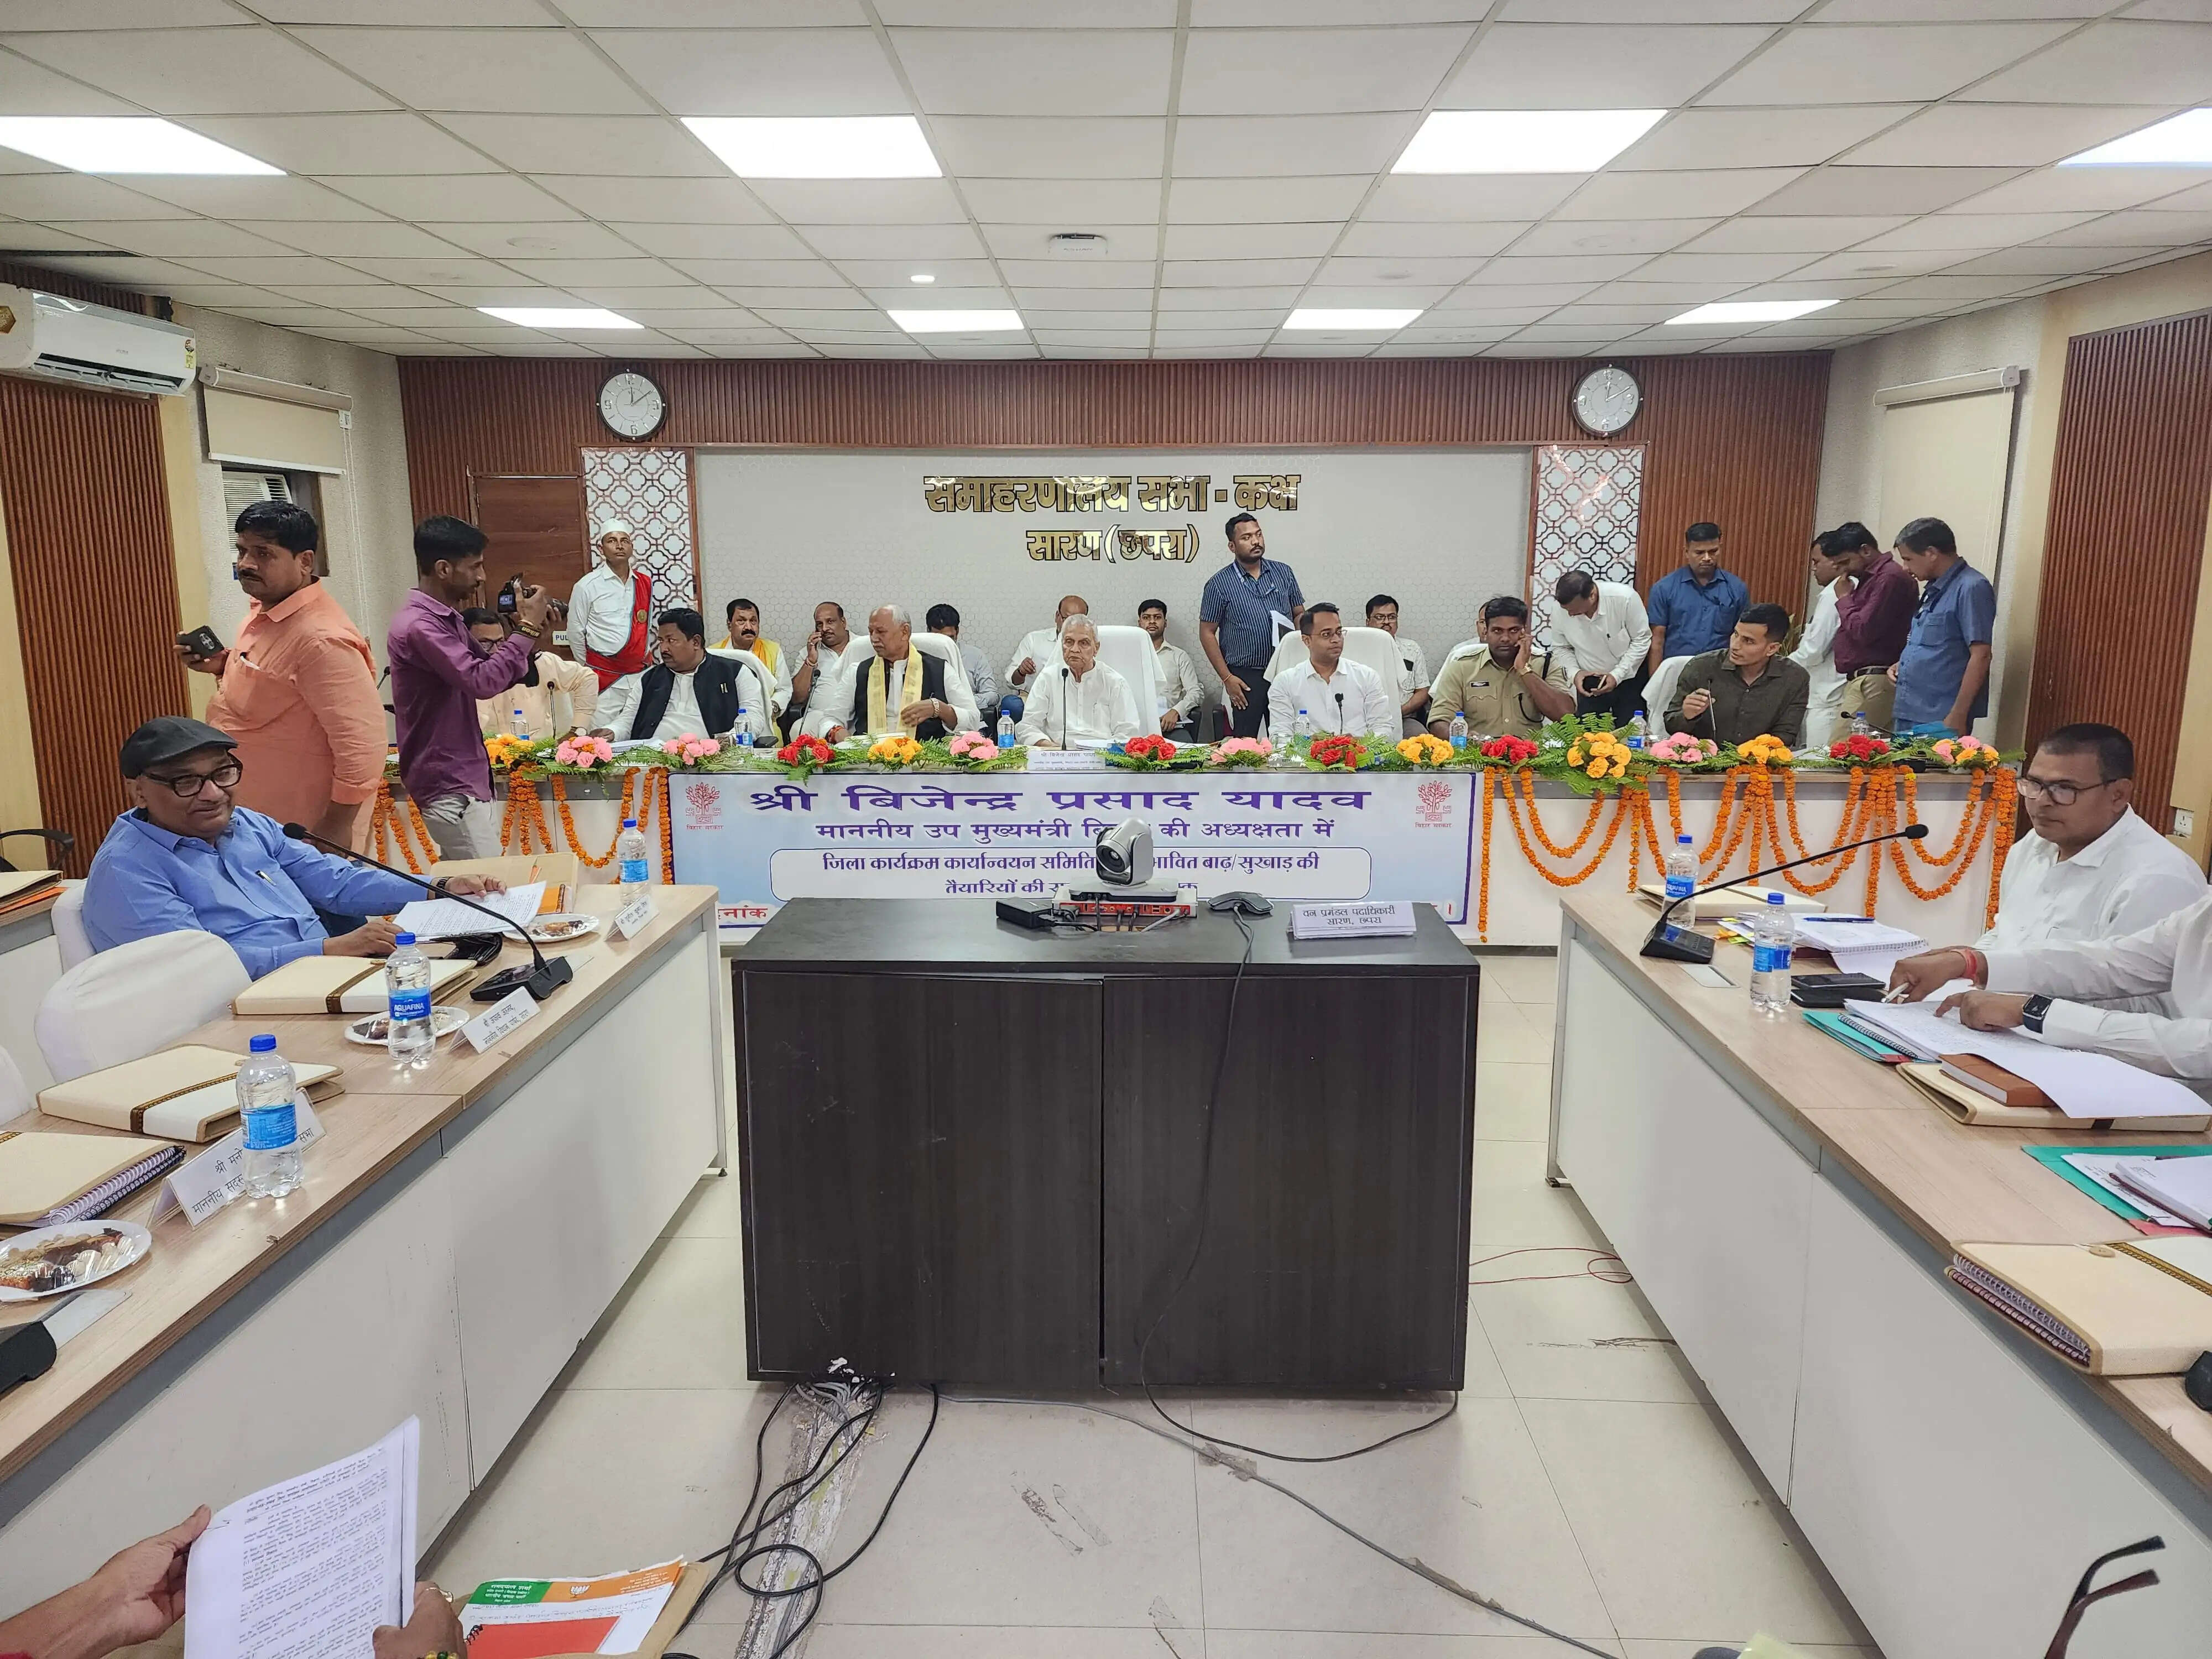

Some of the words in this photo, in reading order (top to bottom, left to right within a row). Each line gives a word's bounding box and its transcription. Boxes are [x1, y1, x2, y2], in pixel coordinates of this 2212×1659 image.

[1137, 475, 1211, 512] सभा
[750, 785, 818, 811] श्री
[841, 785, 1023, 811] बिजेन्द्र
[1046, 792, 1199, 811] प्रसाद
[1222, 791, 1372, 811] यादव
[816, 818, 914, 839] माननीय
[924, 825, 961, 838] उप
[971, 818, 1072, 844] मुख्यमंत्री
[1159, 817, 1191, 838] की
[1202, 823, 1303, 838] अध्यक्षता
[1313, 818, 1335, 838] में
[823, 852, 865, 870] जिला
[870, 852, 940, 870] कार्यक्रम
[944, 852, 1037, 870] कार्यान्वयन
[1040, 852, 1095, 869] समिति
[1297, 851, 1320, 869] की
[946, 879, 1018, 894] तैयारियों
[1021, 879, 1045, 893] की
[718, 905, 768, 920] नांक
[394, 1002, 425, 1012] AQUAFINA
[215, 1160, 228, 1174] श्री
[228, 1147, 244, 1165] मनो
[192, 1189, 225, 1213] माननीय
